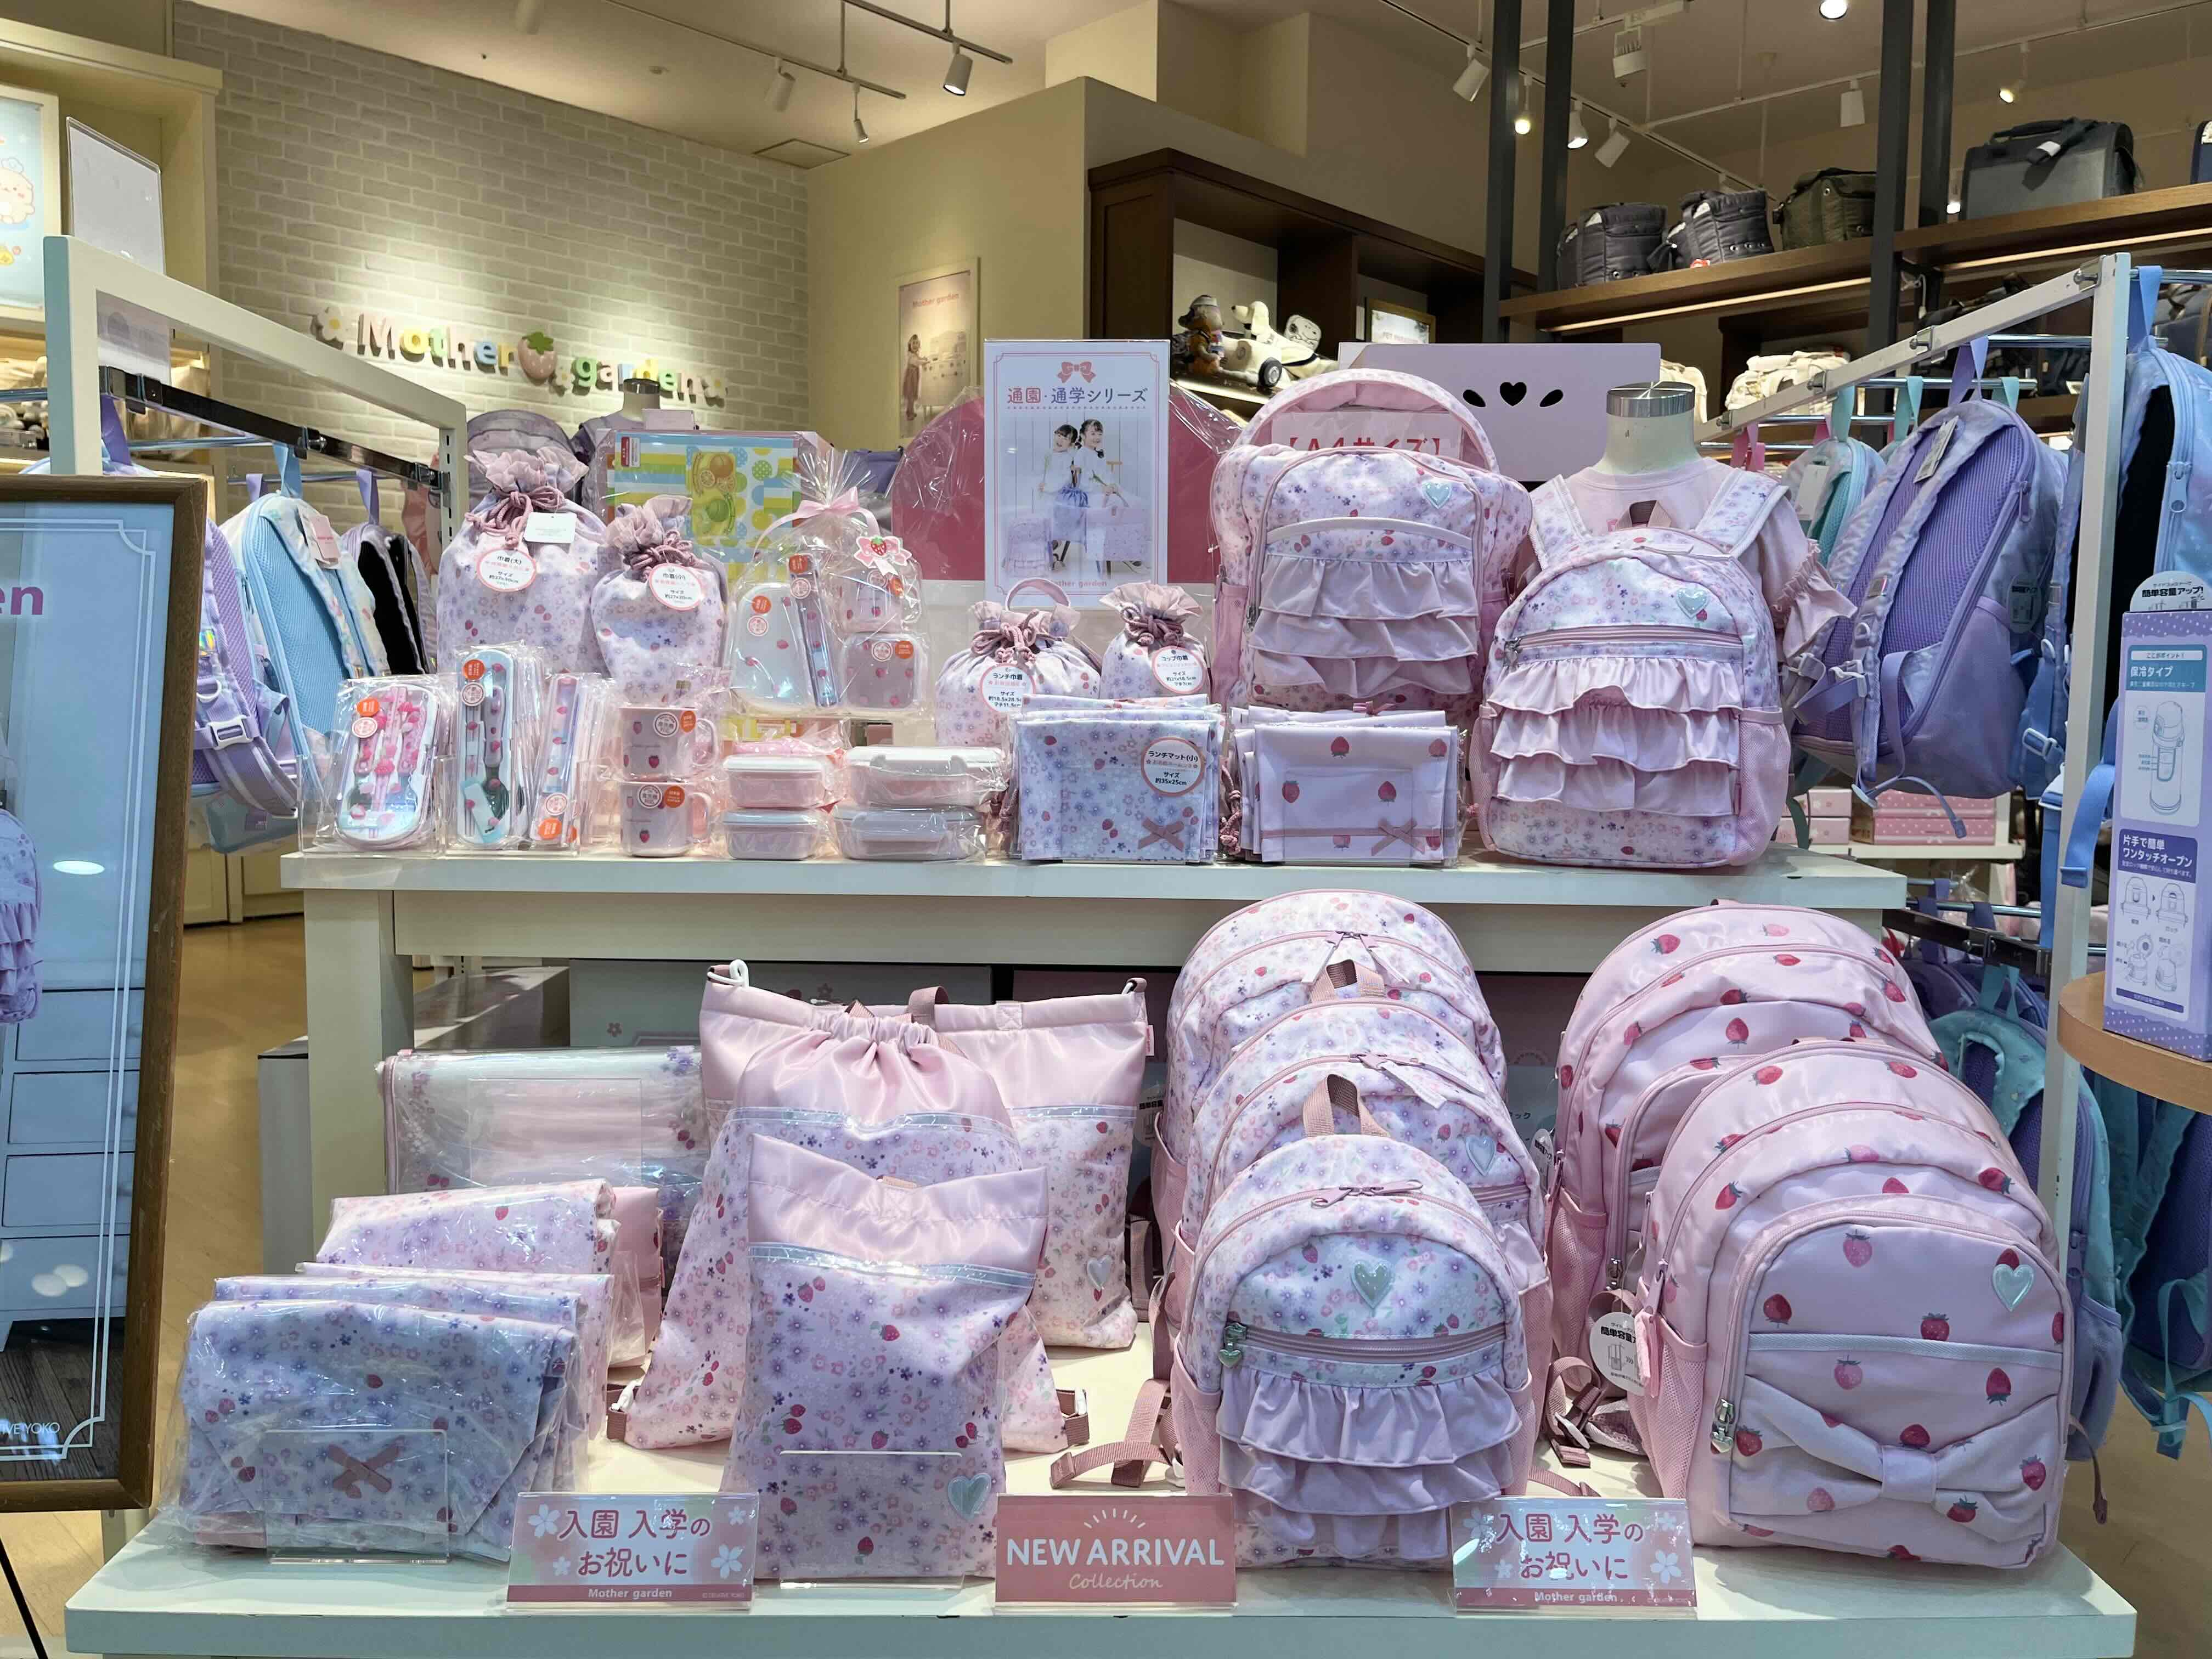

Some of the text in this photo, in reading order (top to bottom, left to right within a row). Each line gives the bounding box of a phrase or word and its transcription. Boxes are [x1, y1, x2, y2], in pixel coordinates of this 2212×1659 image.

[360, 313, 702, 396] Mother garden
[1007, 387, 1148, 404] 通園・通学シリーズ
[0, 586, 43, 615] n
[2131, 665, 2173, 678] 保冷タイプ
[1148, 750, 1198, 762] ランチマット(小)
[2123, 834, 2165, 850] 片手で簡単
[2123, 848, 2193, 867] ワンタッチオープン
[25, 1422, 60, 1434] YOKO
[559, 1509, 710, 1539] 入園 入学の
[1496, 1513, 1644, 1544] 入園 入学の
[1007, 1538, 1225, 1566] NEW ARRIVAL
[578, 1546, 689, 1578] お祝いに
[1520, 1550, 1629, 1581] お祝いに
[1069, 1573, 1164, 1590] Collection
[589, 1588, 673, 1600] Mother garden
[1534, 1592, 1618, 1604] Mother garden
